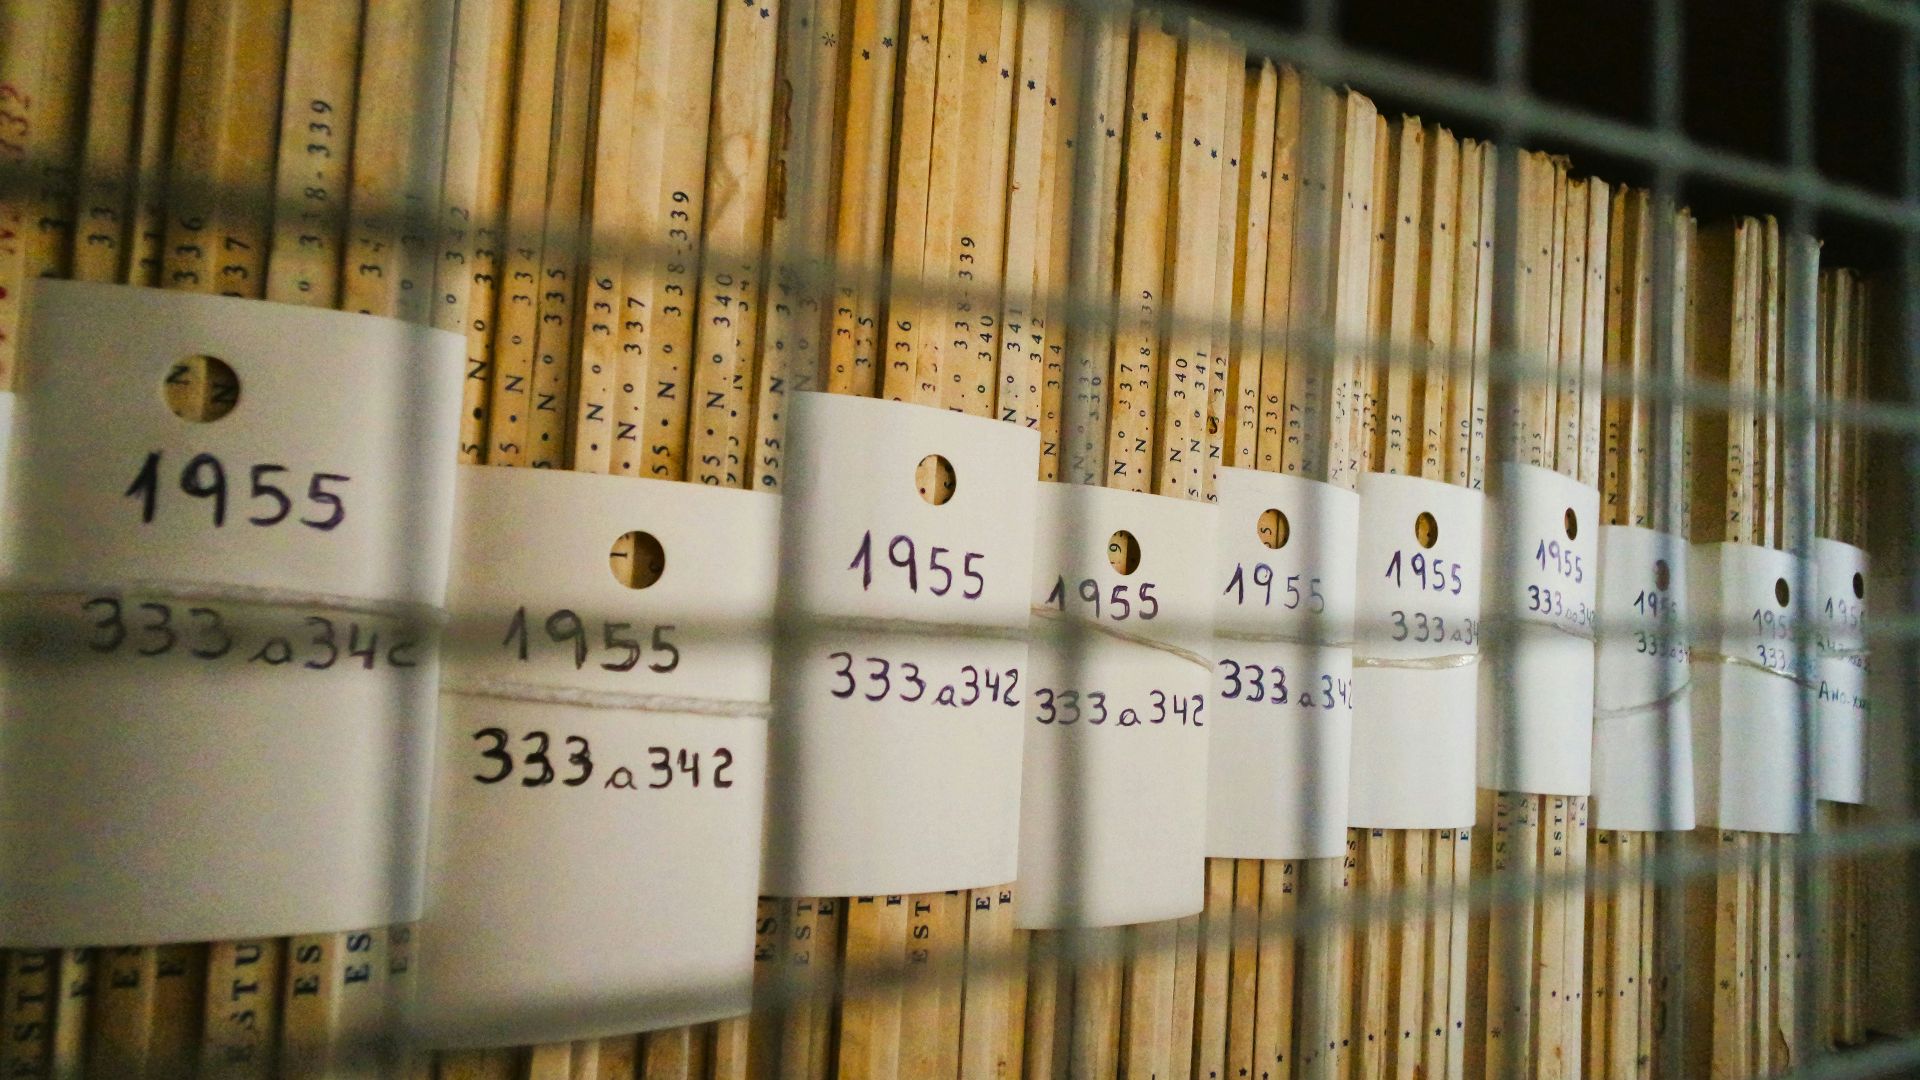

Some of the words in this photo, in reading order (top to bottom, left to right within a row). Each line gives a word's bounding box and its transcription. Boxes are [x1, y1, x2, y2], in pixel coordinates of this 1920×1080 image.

[664, 190, 691, 317] 338-339
[543, 267, 566, 326] 335
[591, 277, 614, 336] 336
[712, 272, 734, 329] 340
[623, 296, 647, 355] 337
[893, 320, 912, 372] 336
[977, 315, 995, 362] 340
[1029, 317, 1046, 364] 342
[1047, 344, 1062, 390] 334
[1118, 363, 1134, 411] 337
[1173, 357, 1188, 400] 340
[1194, 351, 1208, 391] 341
[1214, 356, 1228, 398] 342
[1242, 388, 1256, 430] 335
[1265, 393, 1280, 436] 336
[1288, 403, 1301, 445] 337
[1390, 413, 1402, 452] 335
[1475, 407, 1486, 440] 341
[1426, 428, 1439, 467] 337
[124, 449, 352, 531] 1955
[846, 528, 985, 601] 1955
[1384, 549, 1464, 596] 1955
[1535, 538, 1584, 585] 1955
[1045, 573, 1160, 621] 1955
[1222, 561, 1326, 615] 1955
[502, 605, 681, 674] 1955
[1390, 609, 1446, 644] 333
[471, 727, 594, 789] 333
[647, 745, 734, 790] 342
[911, 900, 931, 966] EST
[344, 932, 372, 986] ES
